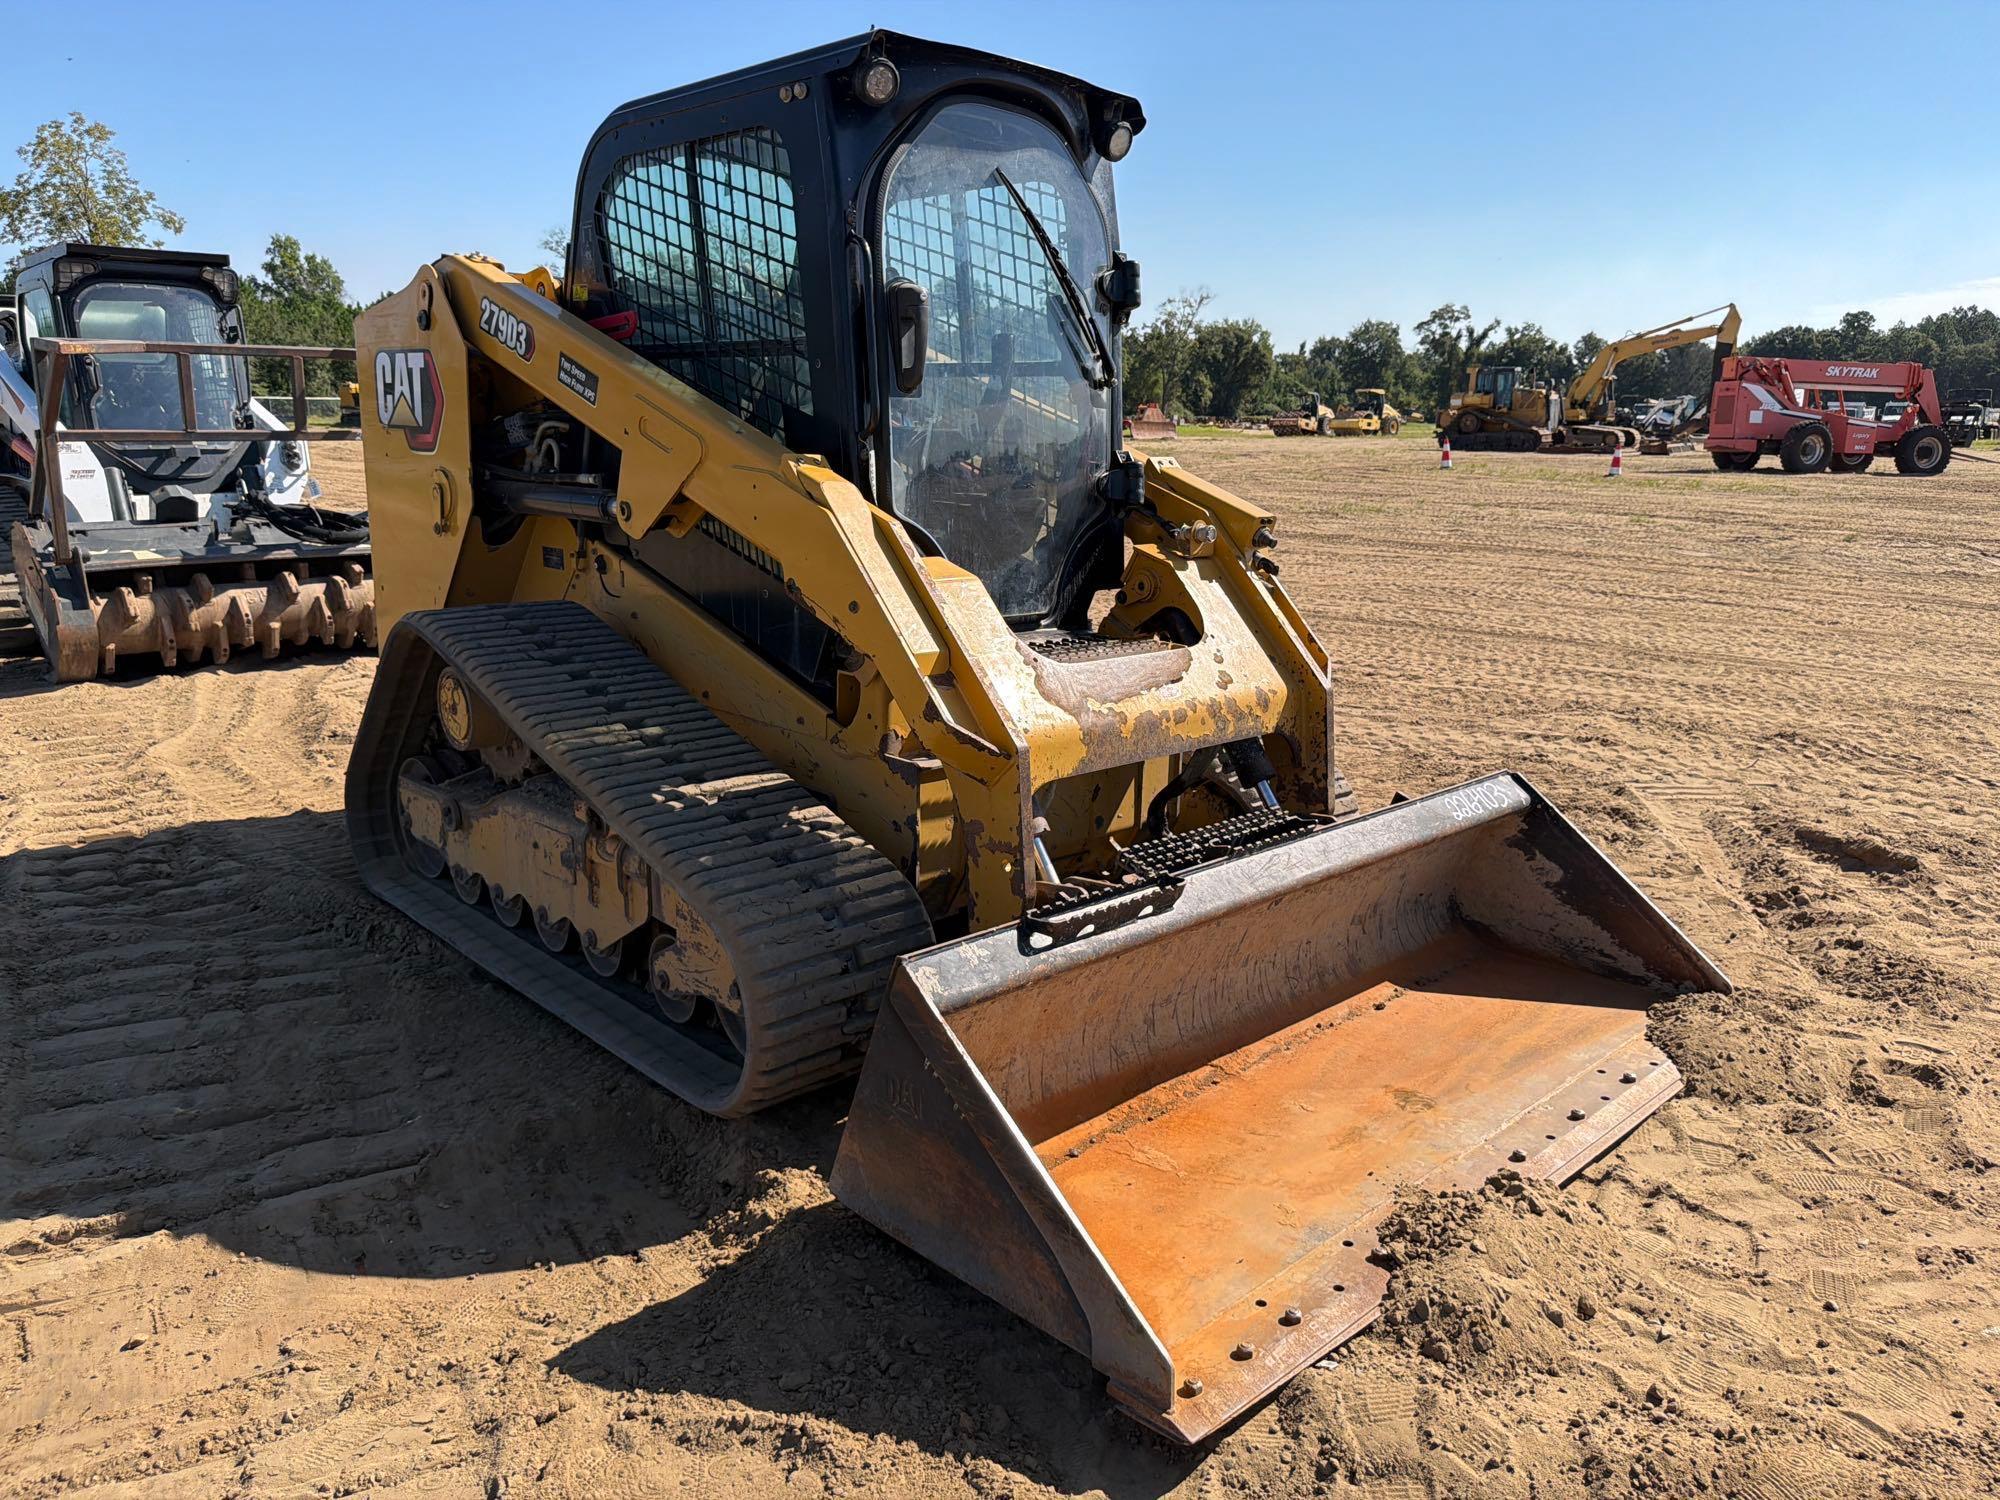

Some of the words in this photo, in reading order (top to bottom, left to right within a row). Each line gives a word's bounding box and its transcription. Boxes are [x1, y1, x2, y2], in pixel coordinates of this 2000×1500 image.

[480, 298, 527, 356] 279D3
[376, 352, 424, 427] CAT
[1825, 366, 1880, 379] SKYTRAK
[1444, 782, 1509, 820] 226403
